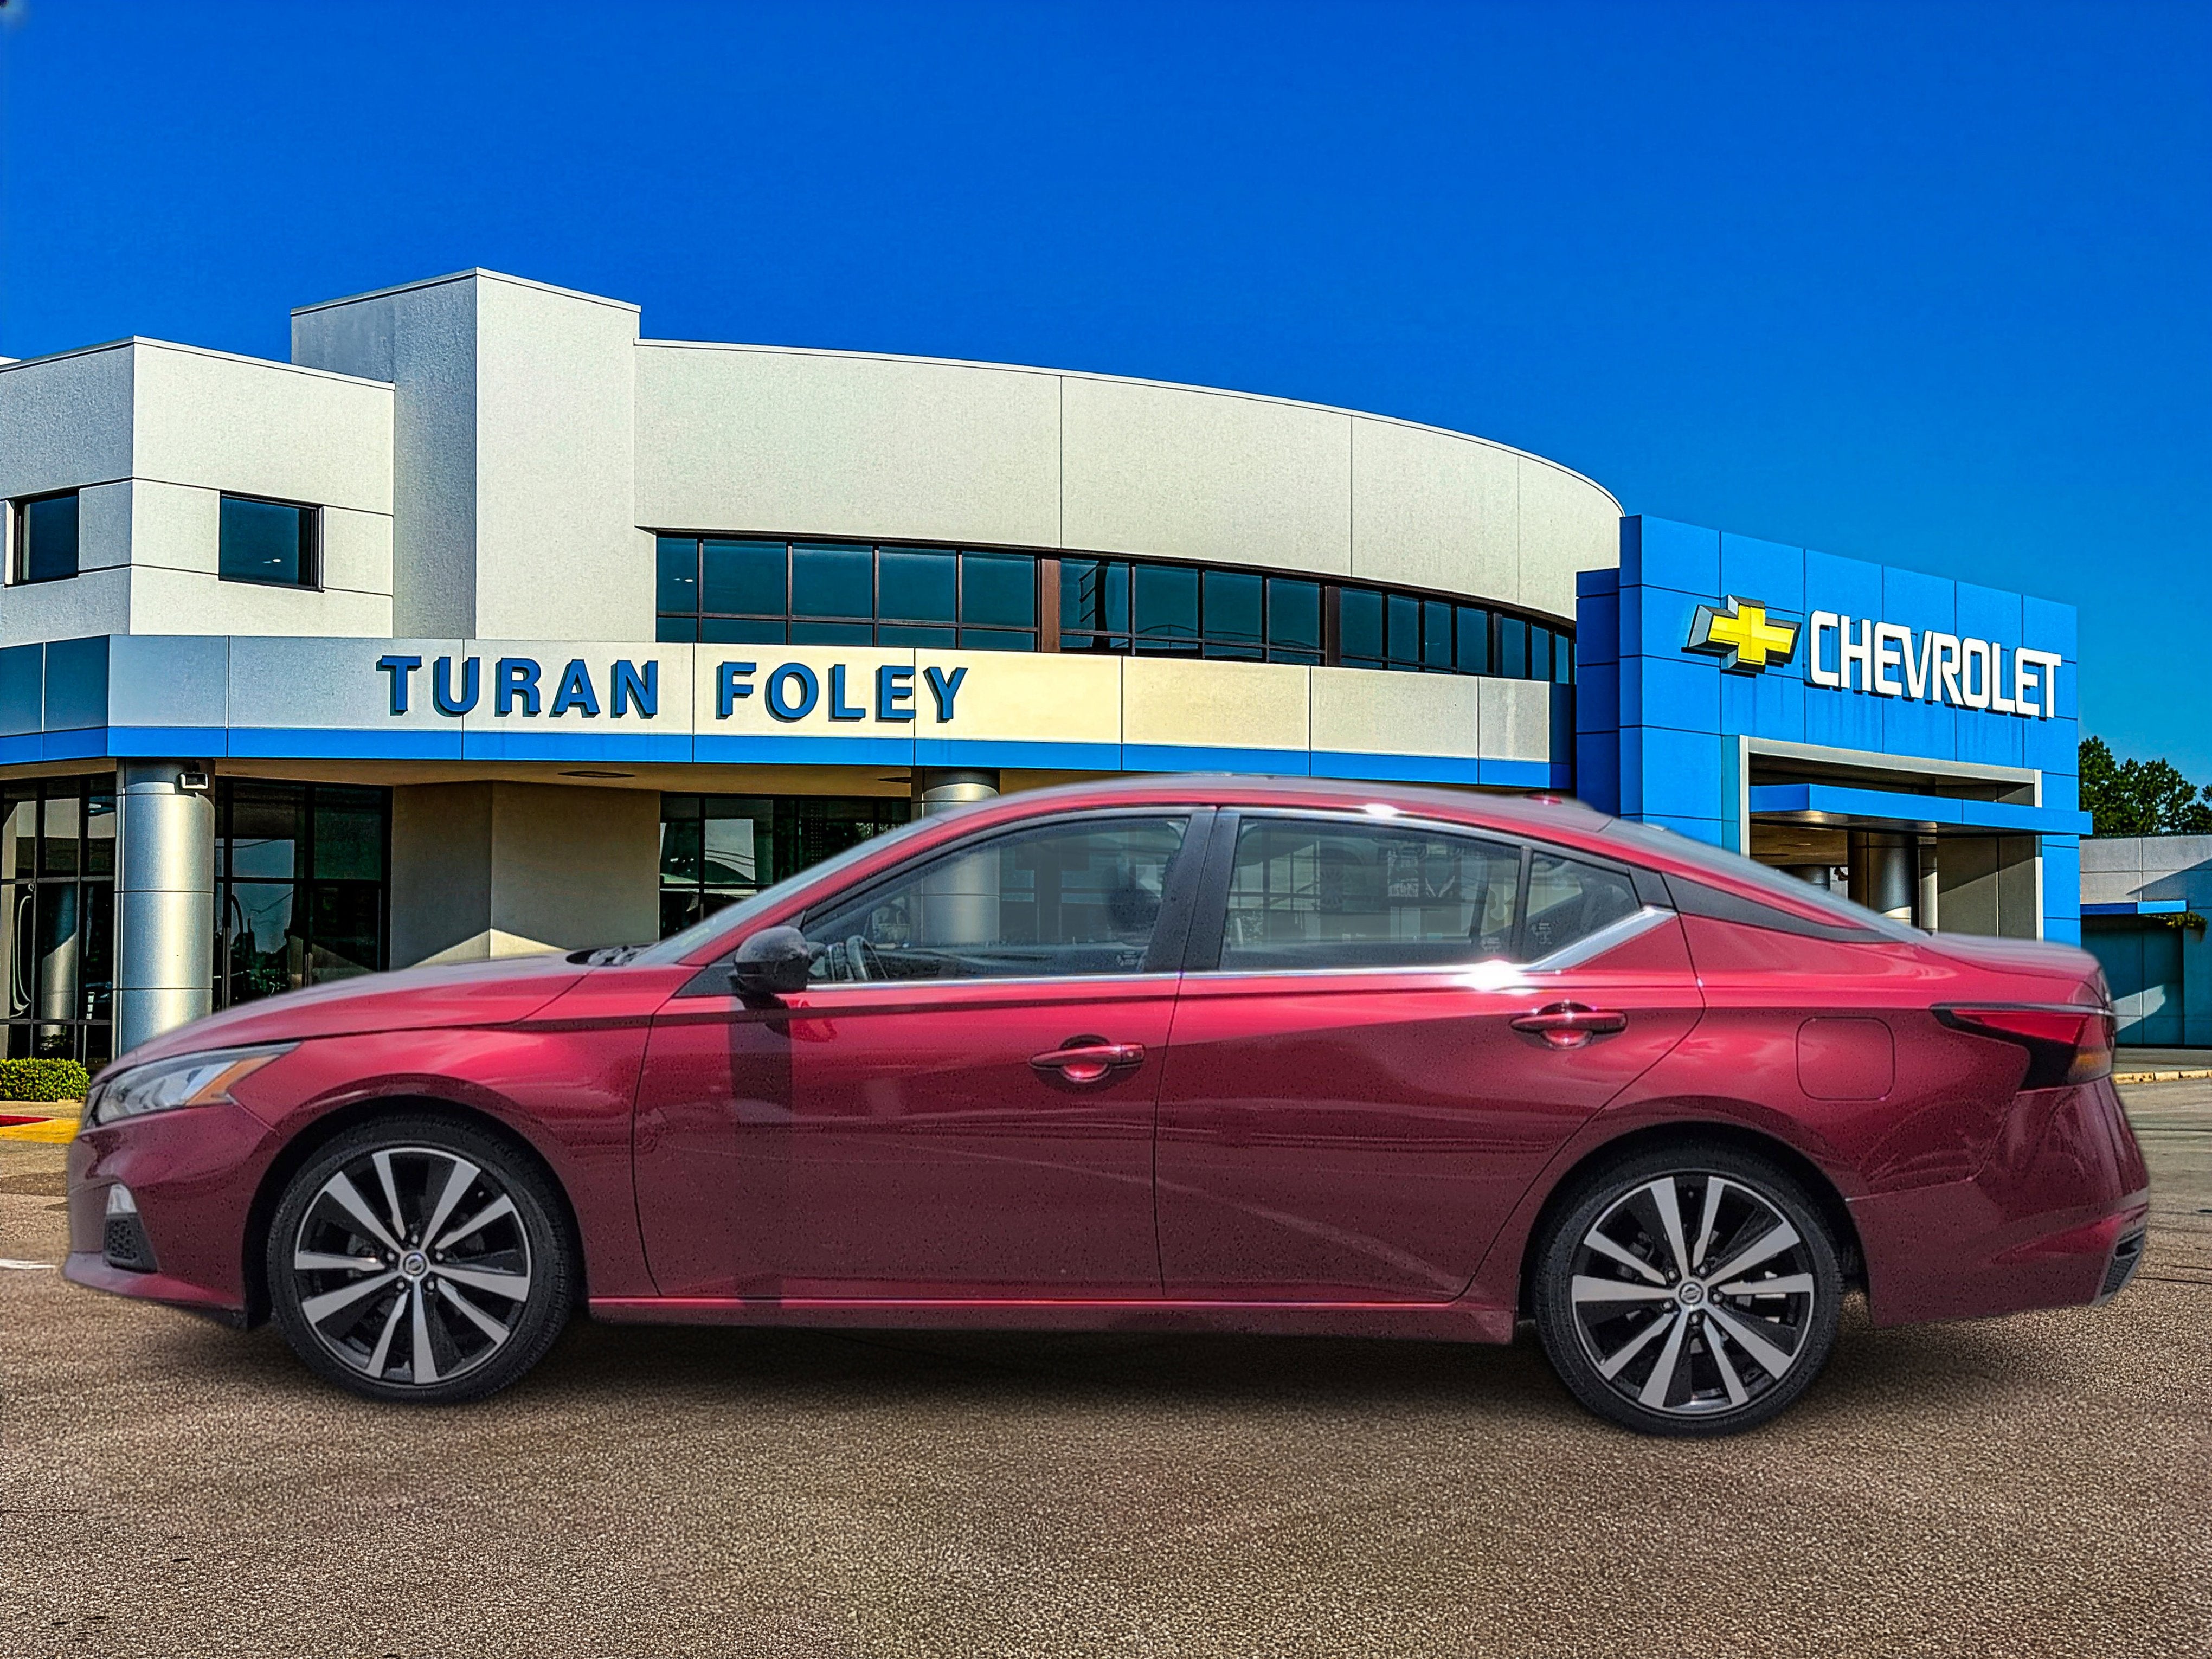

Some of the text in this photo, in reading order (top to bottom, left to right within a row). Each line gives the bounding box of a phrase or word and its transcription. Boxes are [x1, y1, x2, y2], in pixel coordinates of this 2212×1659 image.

[376, 655, 969, 723] TURAN FOLEY
[1810, 610, 2061, 718] CHEVROLET
